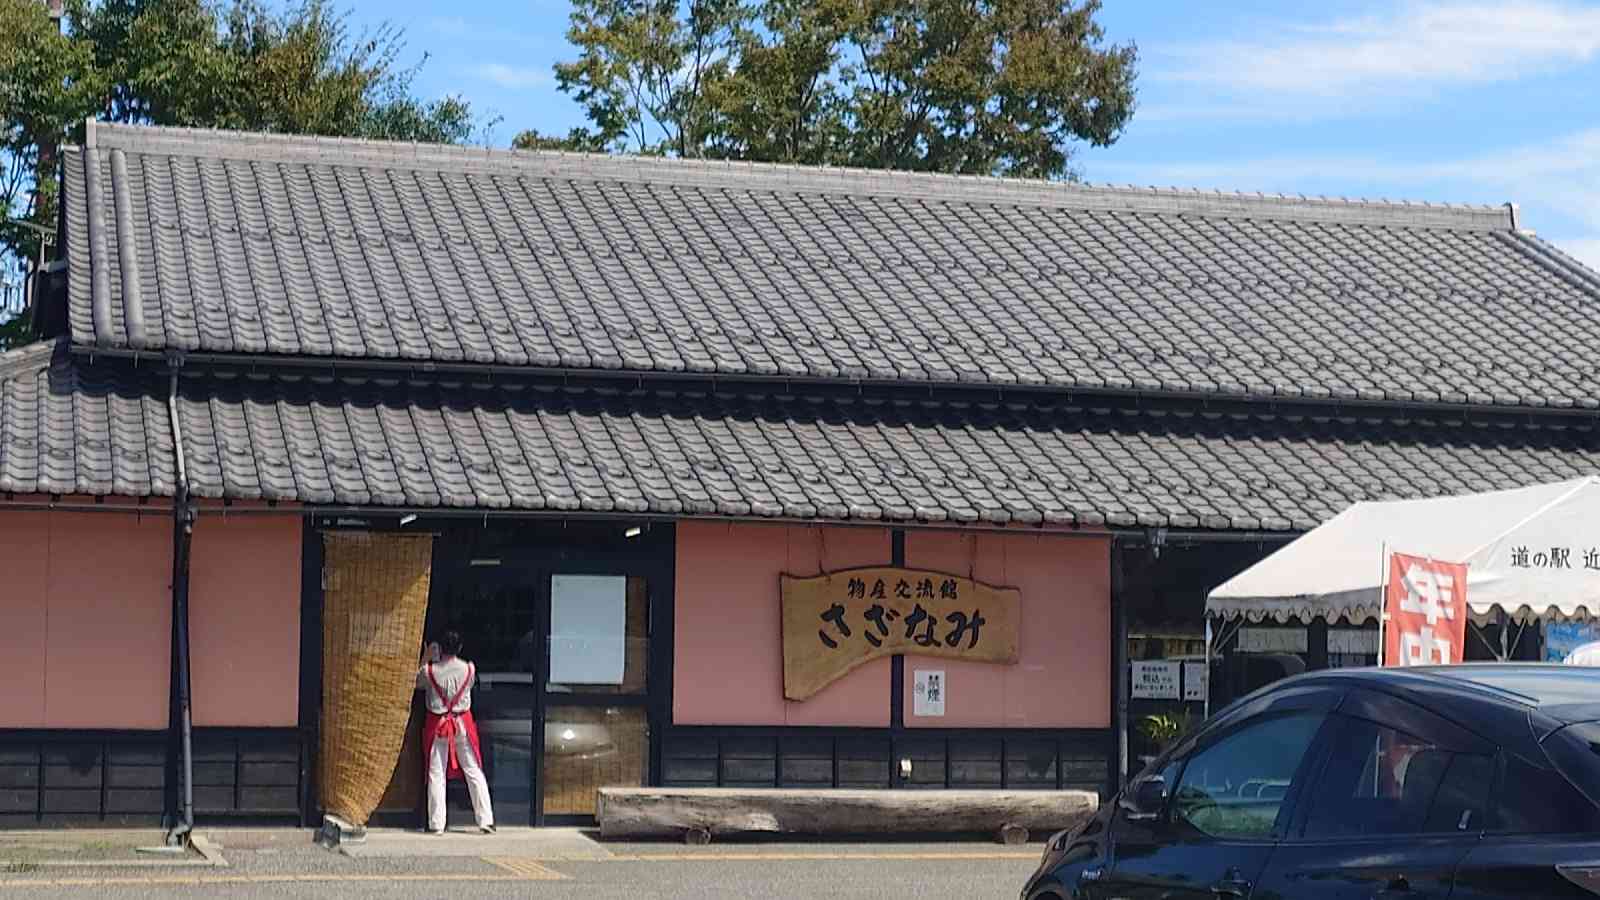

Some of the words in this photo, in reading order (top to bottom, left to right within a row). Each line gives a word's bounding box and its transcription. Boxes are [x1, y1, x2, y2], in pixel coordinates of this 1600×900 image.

[1511, 546, 1571, 569] 道の駅
[847, 578, 960, 600] 物産交流館
[818, 602, 986, 649] さざなみ
